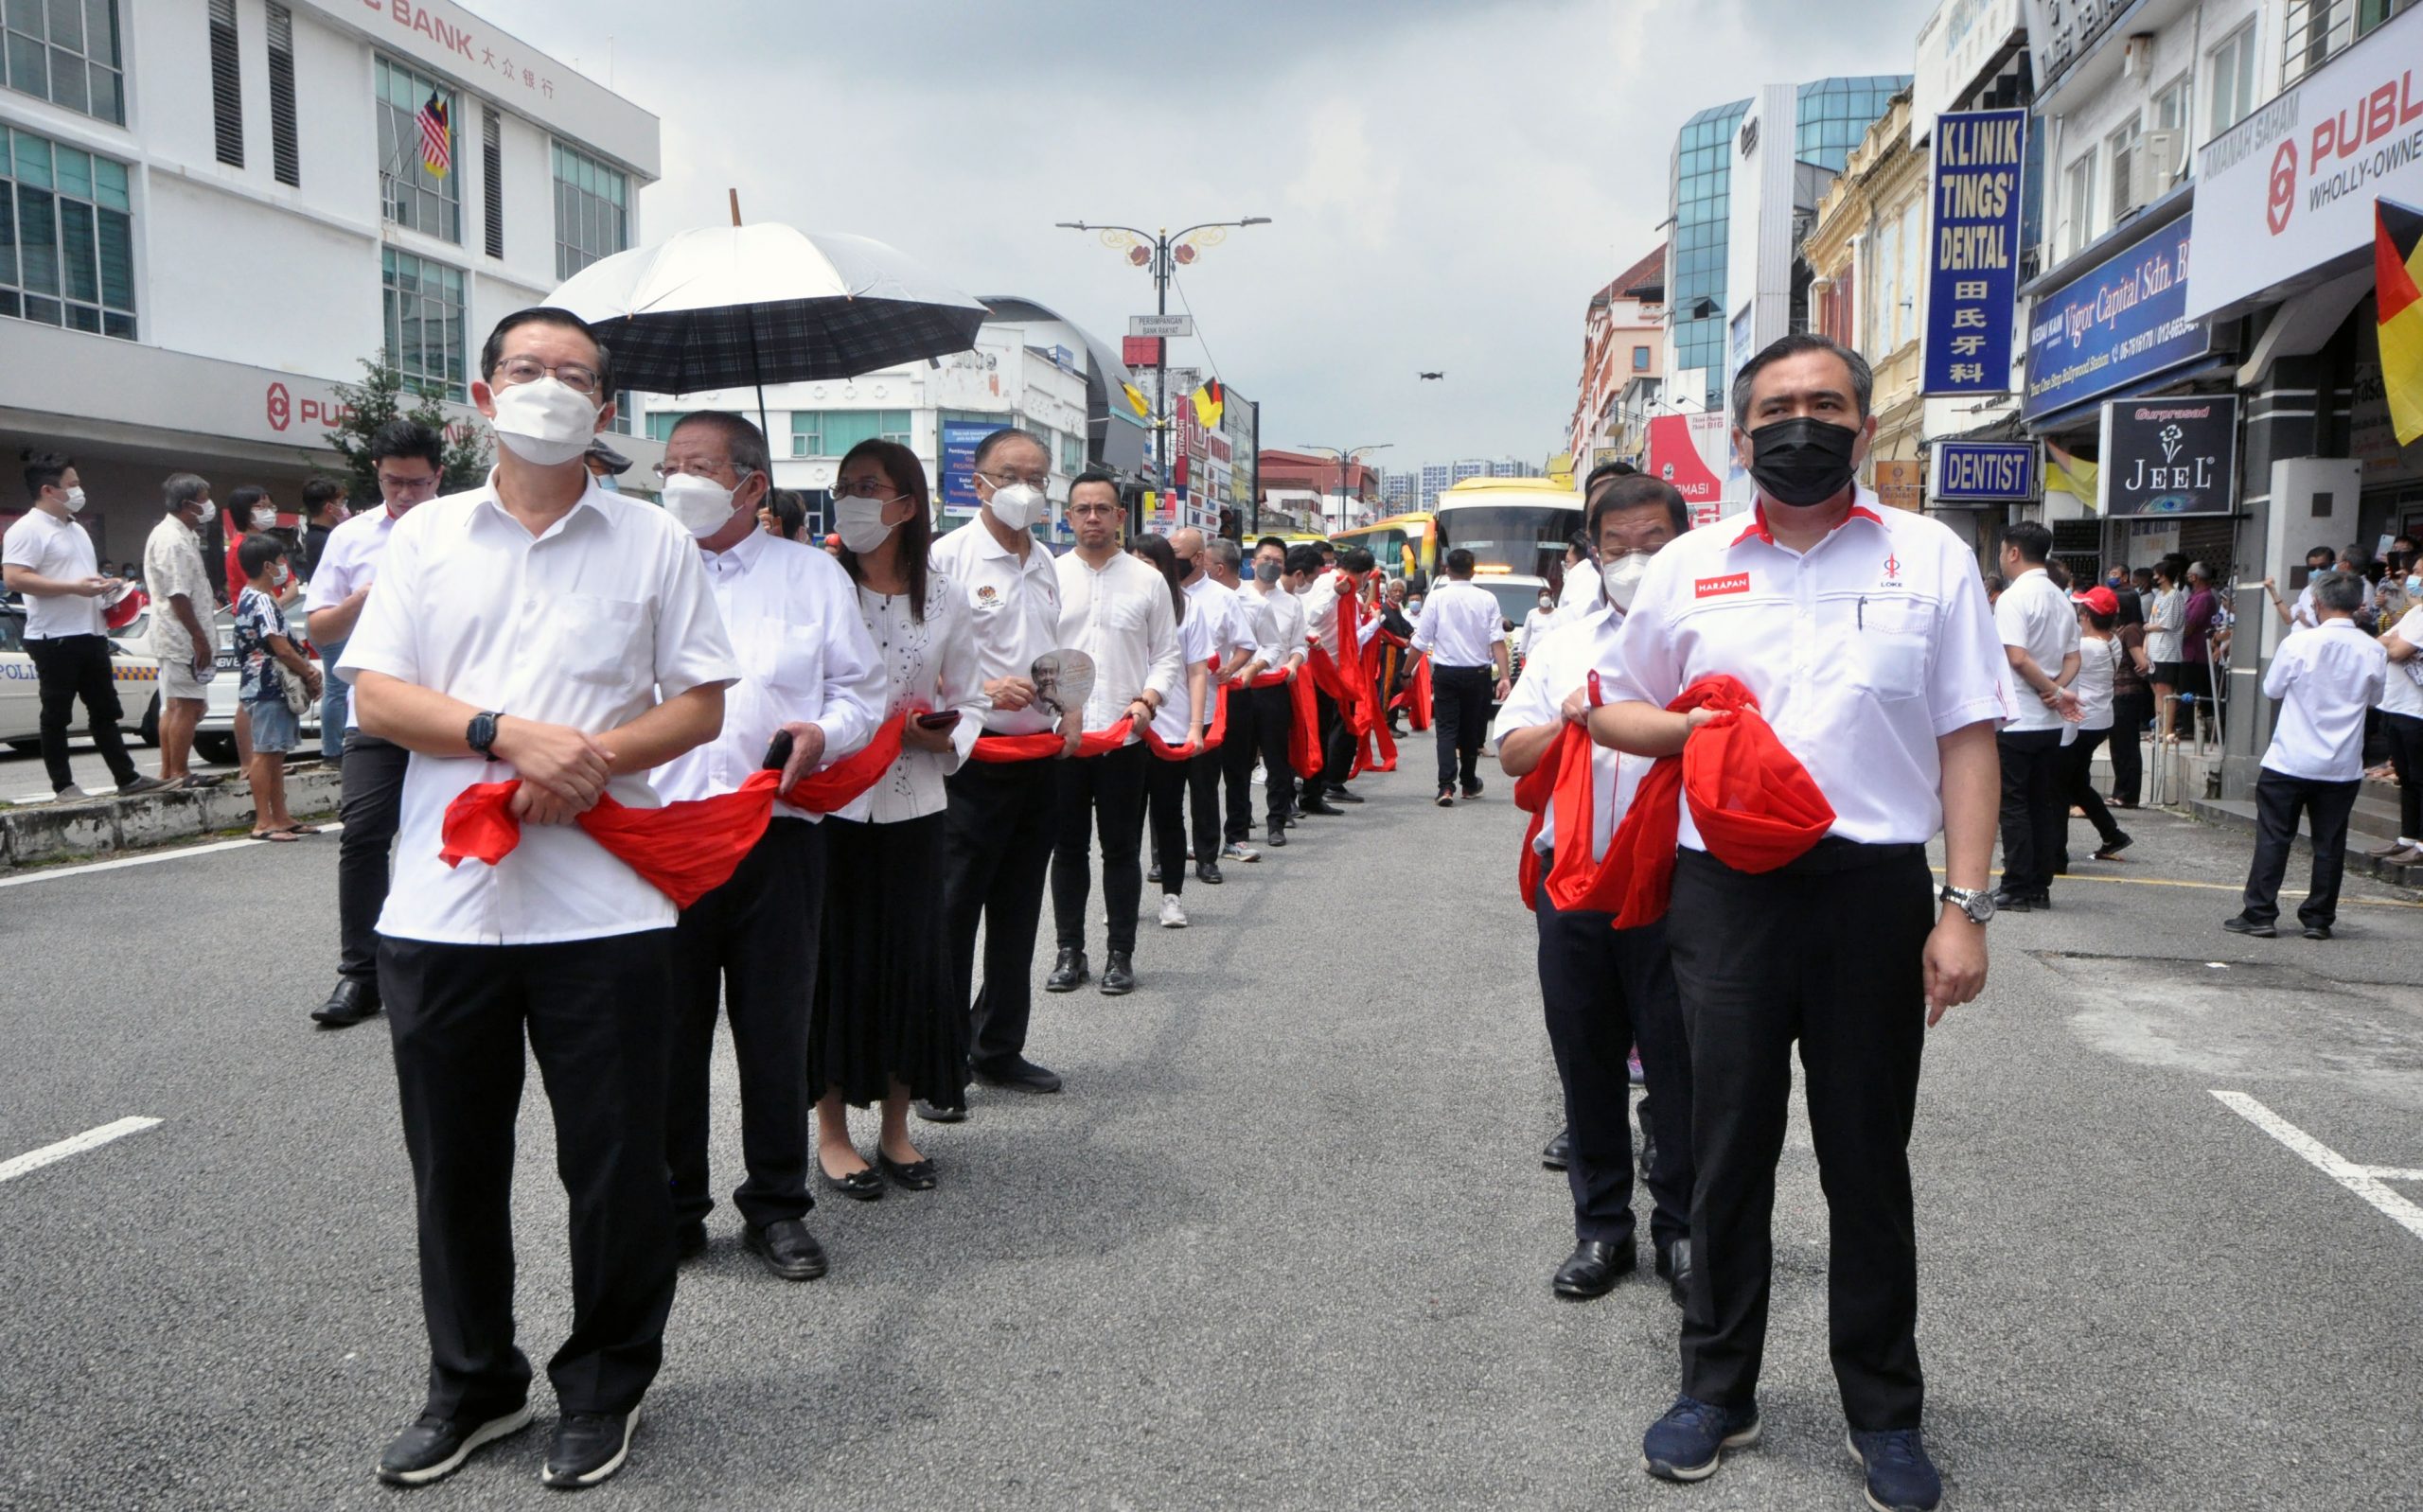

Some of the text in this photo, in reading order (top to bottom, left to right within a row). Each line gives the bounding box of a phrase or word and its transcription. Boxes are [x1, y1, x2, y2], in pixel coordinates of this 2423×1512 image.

[392, 0, 475, 62] BANK
[482, 47, 554, 99] 大众银行
[1941, 119, 2020, 167] KLINIK
[2203, 92, 2300, 184] AMANAH SAHAM
[1941, 172, 2014, 219] TINGS'
[1939, 225, 2007, 271] DENTAL
[1139, 317, 1183, 325] PERSIMPANGAN
[2065, 304, 2096, 348] Vigor
[2096, 267, 2140, 330] Capital
[2142, 253, 2172, 301] Sdn.
[1158, 326, 1179, 335] RAKYAT
[1949, 280, 1988, 384] 田氏牙科
[1707, 421, 1724, 430] BIG
[2134, 405, 2210, 423] Gurprasad
[1177, 418, 1186, 457] HITACHI
[1947, 452, 2025, 491] DENTIST
[1698, 578, 1747, 592] HARAPAN
